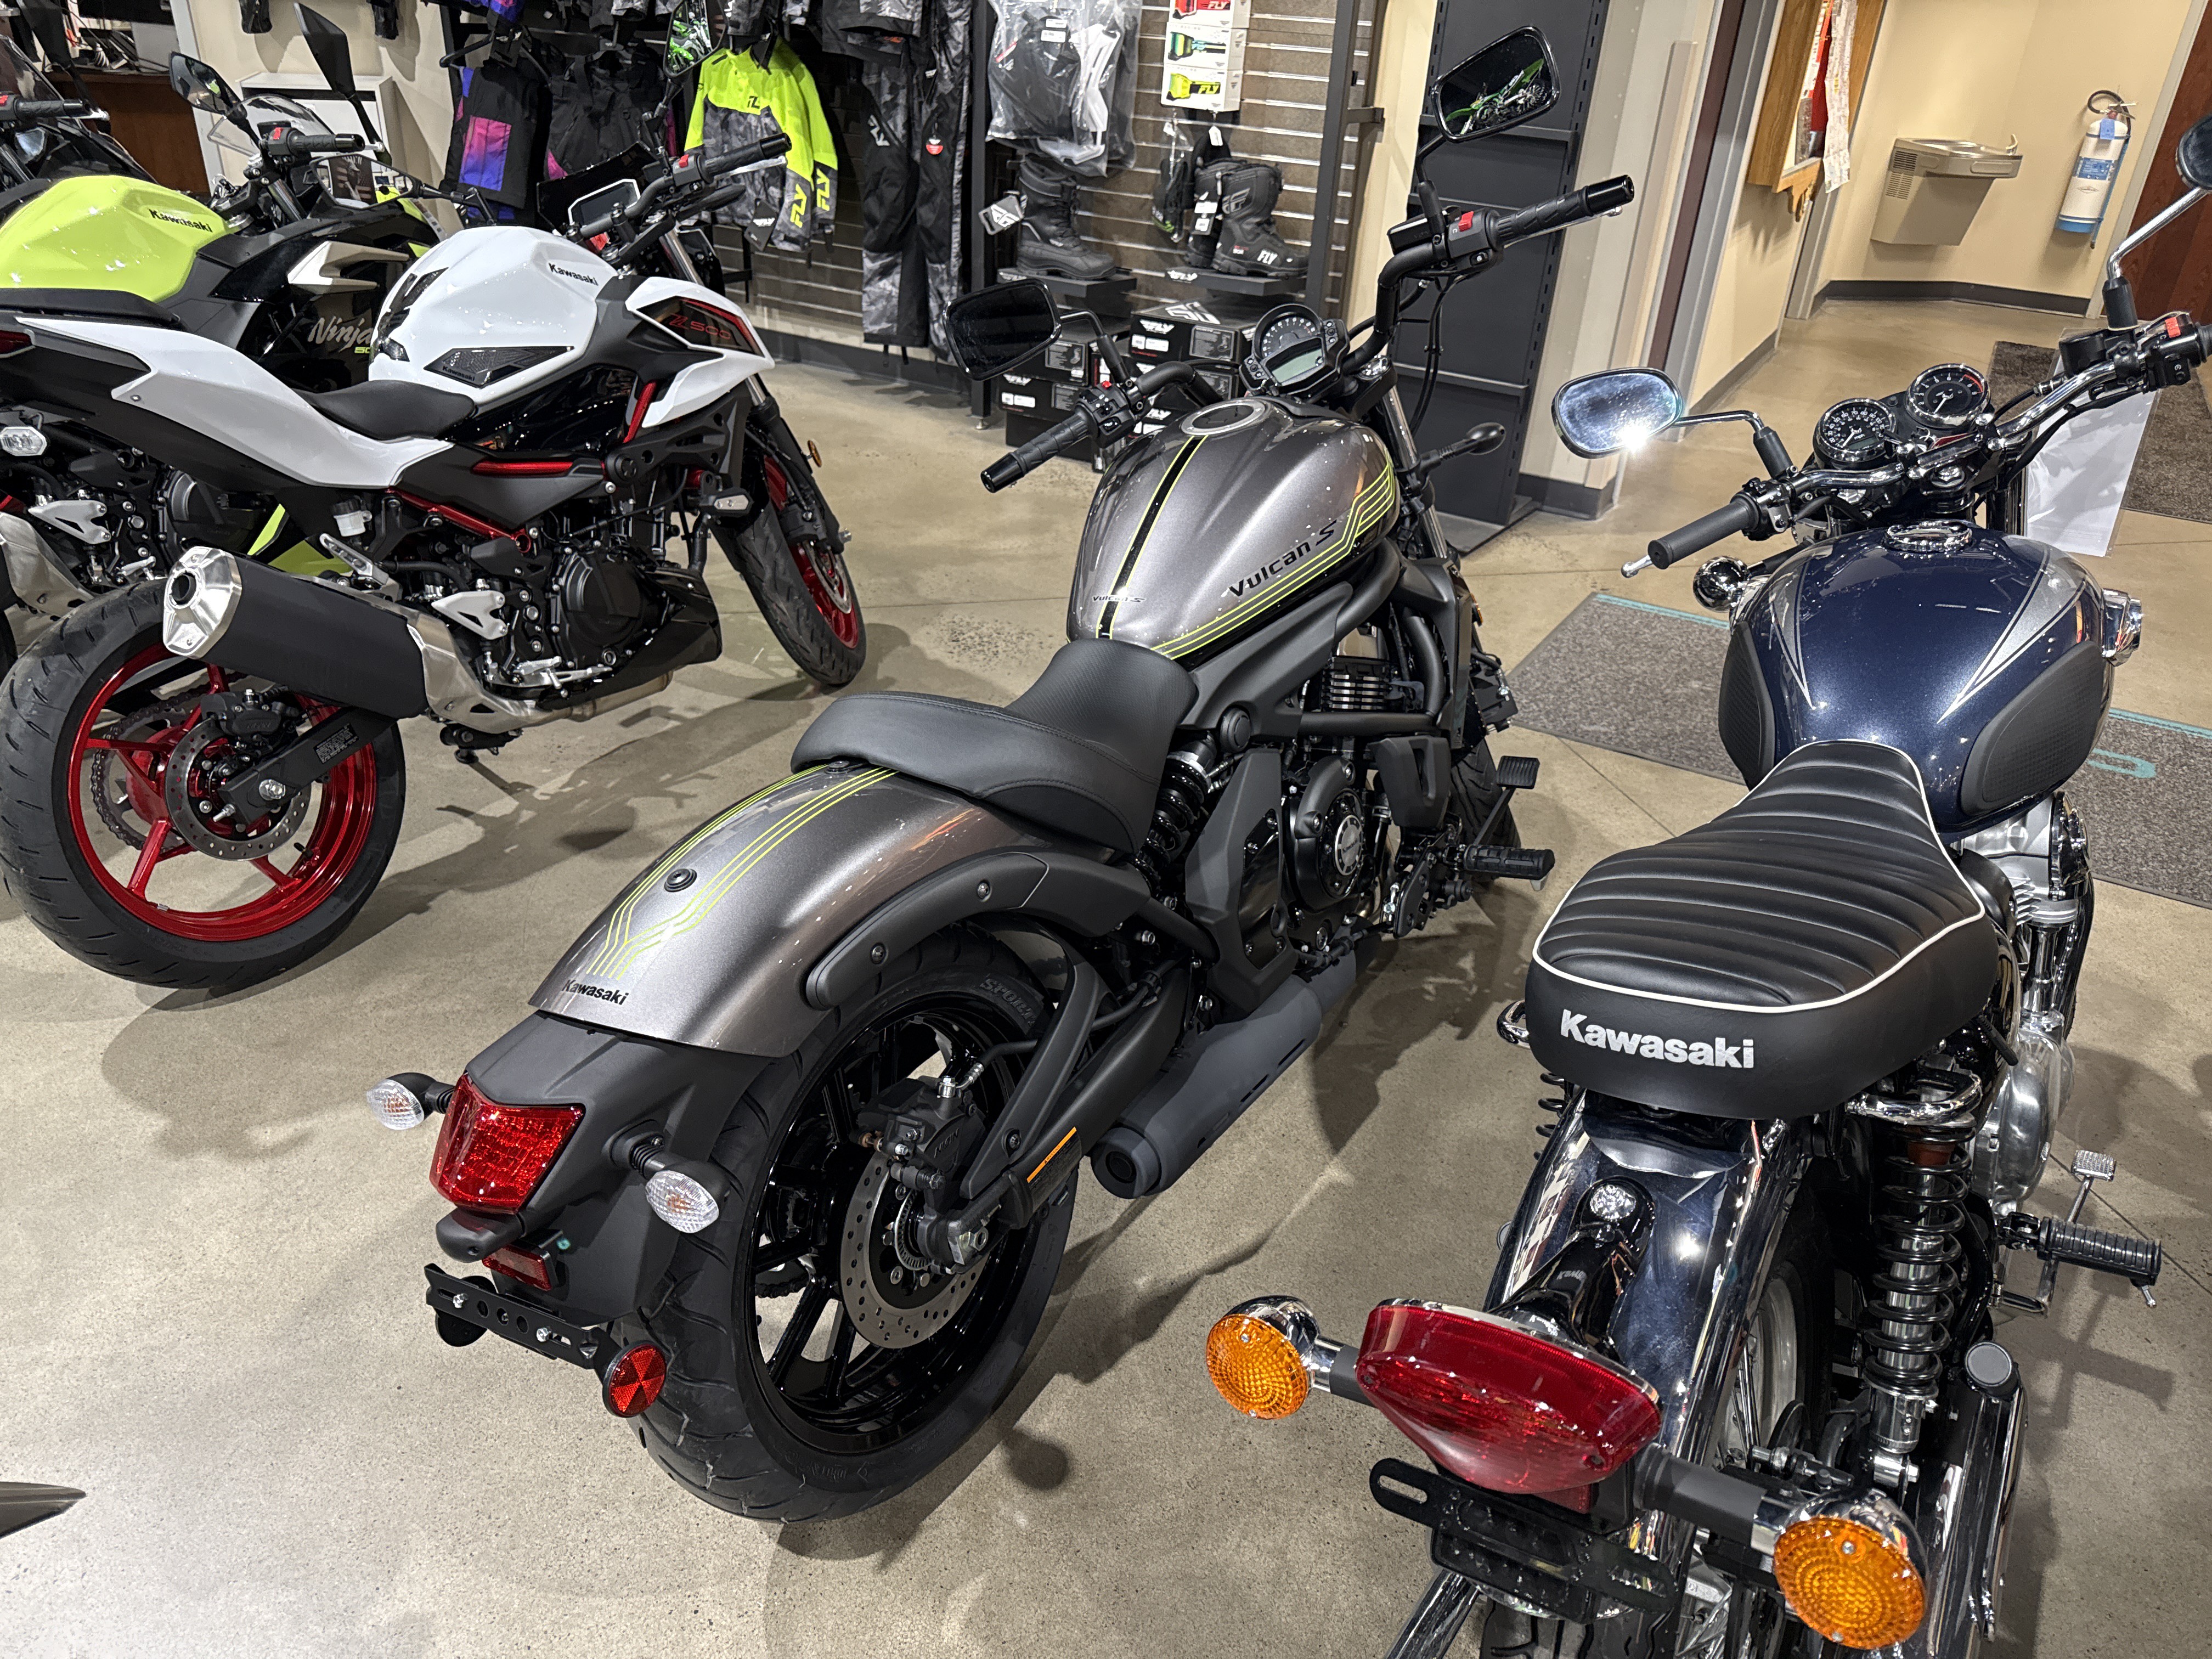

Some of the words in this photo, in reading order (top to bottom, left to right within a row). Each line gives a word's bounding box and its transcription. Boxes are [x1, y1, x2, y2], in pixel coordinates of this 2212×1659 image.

[1207, 1, 1227, 9] FLY
[1198, 85, 1220, 94] FLY
[816, 168, 830, 211] FLY
[790, 184, 807, 228] FLY
[147, 208, 213, 233] Kawasaki
[1257, 250, 1278, 265] FLY
[549, 263, 599, 286] Kawasaki
[307, 315, 374, 353] Ninja
[442, 365, 476, 382] Kawasaki
[1229, 542, 1311, 597] Vulcan
[1316, 519, 1338, 546] S
[561, 979, 629, 1005] Kawasaki
[1561, 1009, 1754, 1068] Kawasaki
